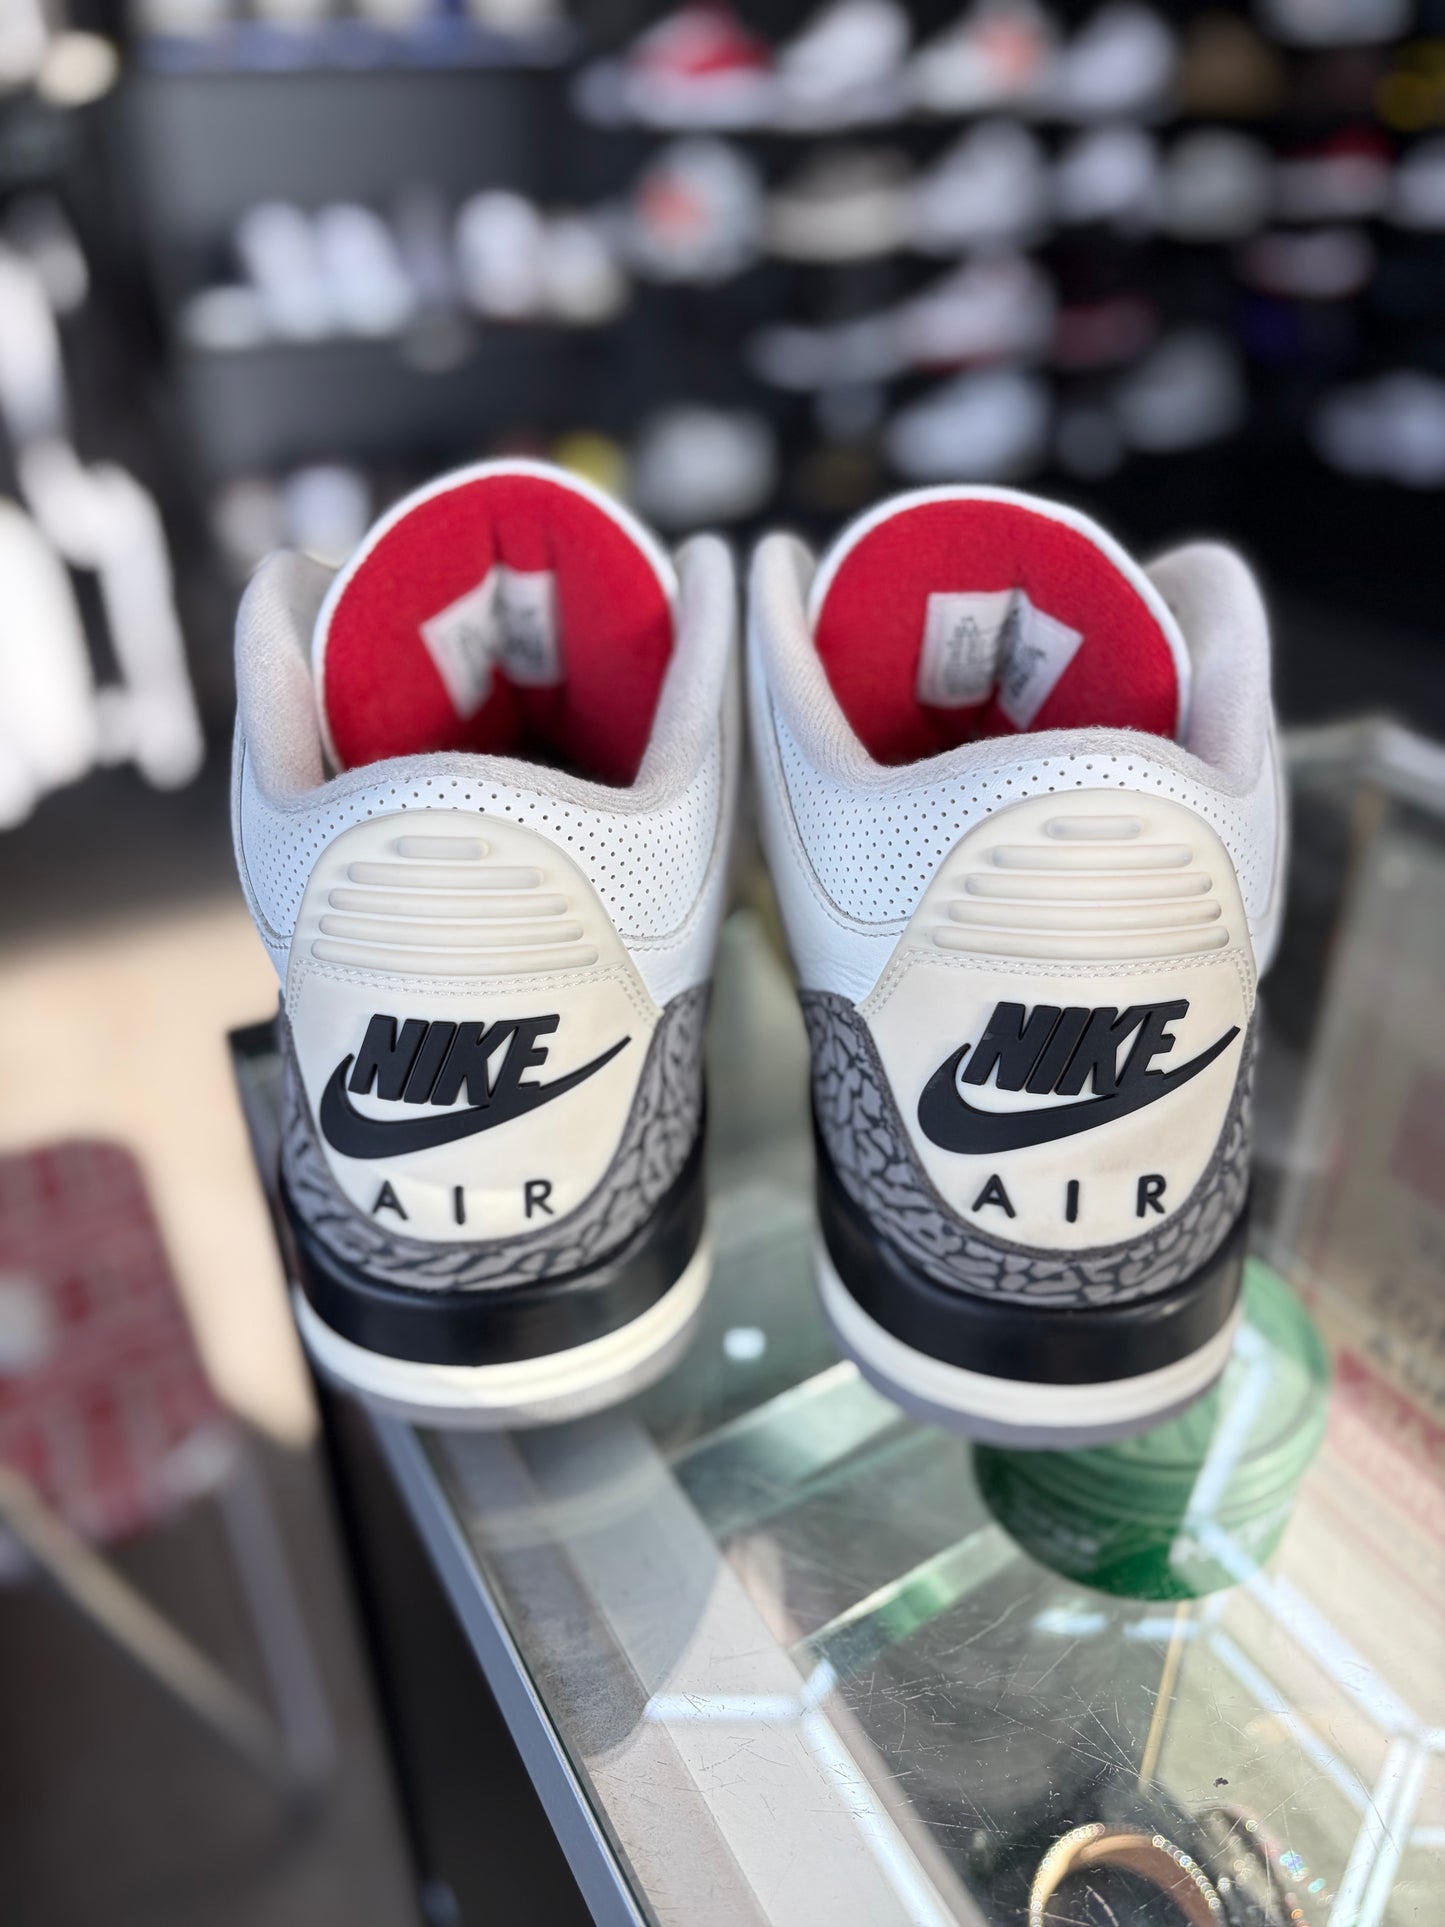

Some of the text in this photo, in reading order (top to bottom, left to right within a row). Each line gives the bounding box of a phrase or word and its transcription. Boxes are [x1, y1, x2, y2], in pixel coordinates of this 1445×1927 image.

[348, 1014, 560, 1106] NIKE
[961, 999, 1190, 1096] NIKE
[372, 1180, 554, 1225] AIR
[972, 1174, 1165, 1223] AIR
